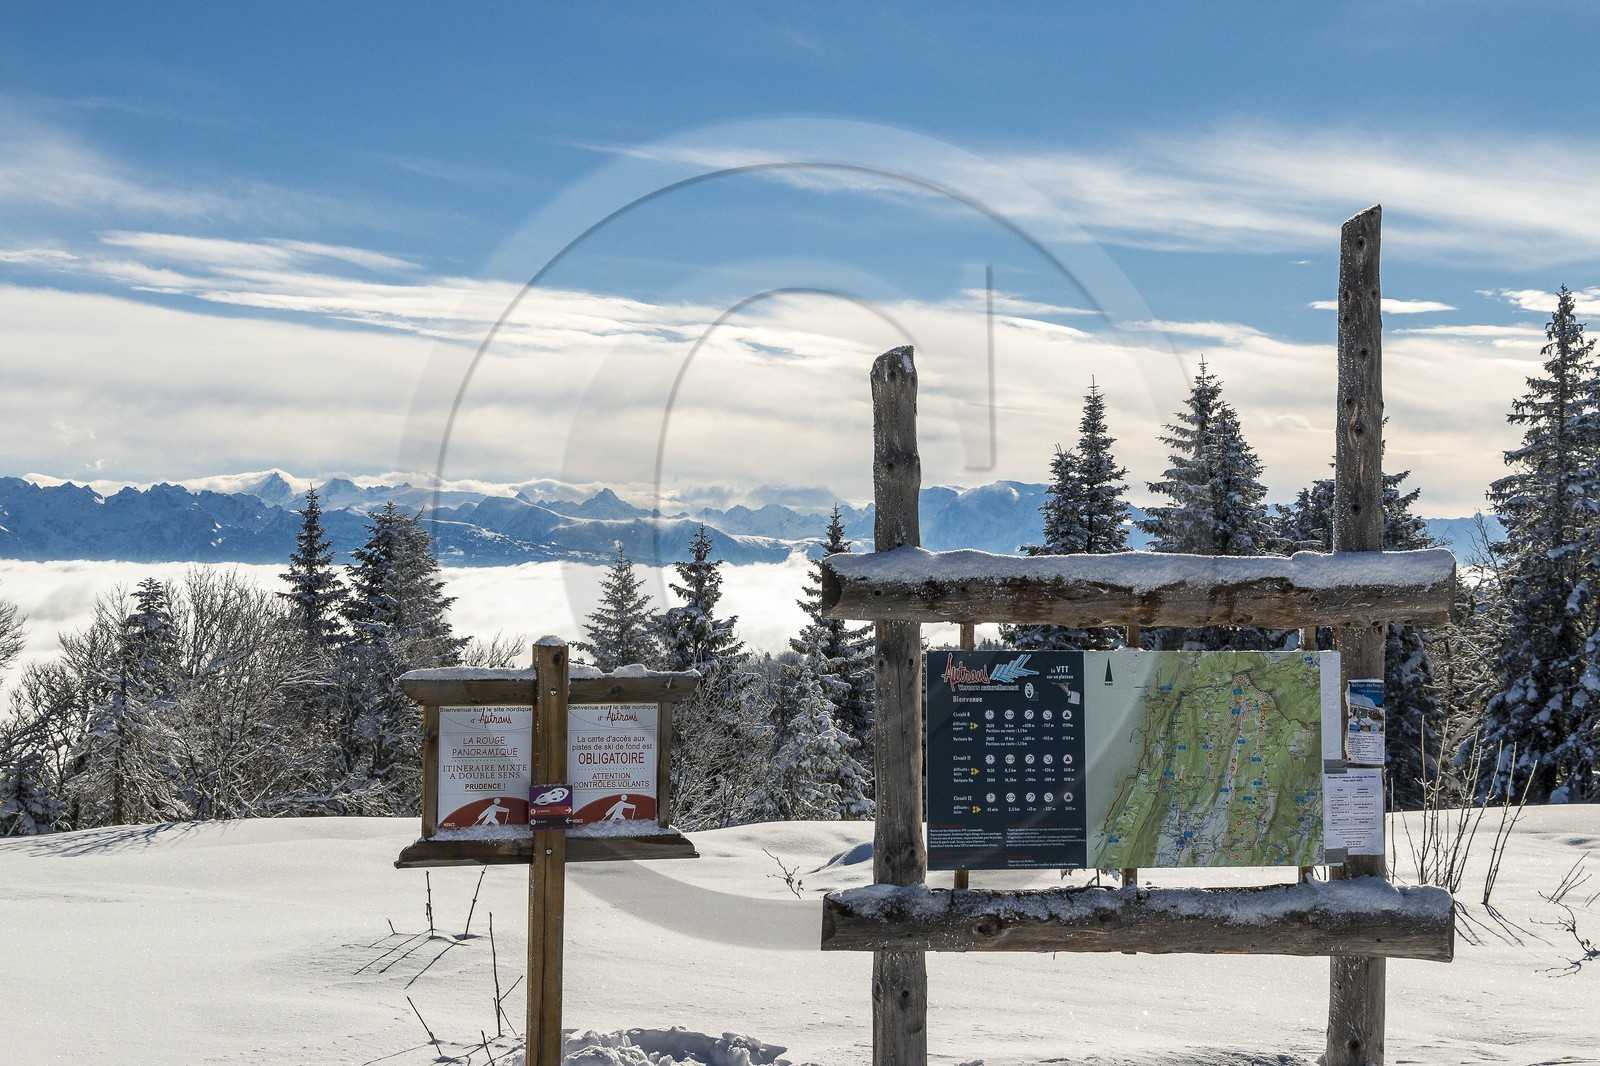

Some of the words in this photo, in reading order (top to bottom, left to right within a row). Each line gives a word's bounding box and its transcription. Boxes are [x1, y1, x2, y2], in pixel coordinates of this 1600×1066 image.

[452, 748, 518, 757] PANORAMIQUE
[572, 744, 592, 752] pistes
[578, 752, 644, 764] OBLIGATOIRE
